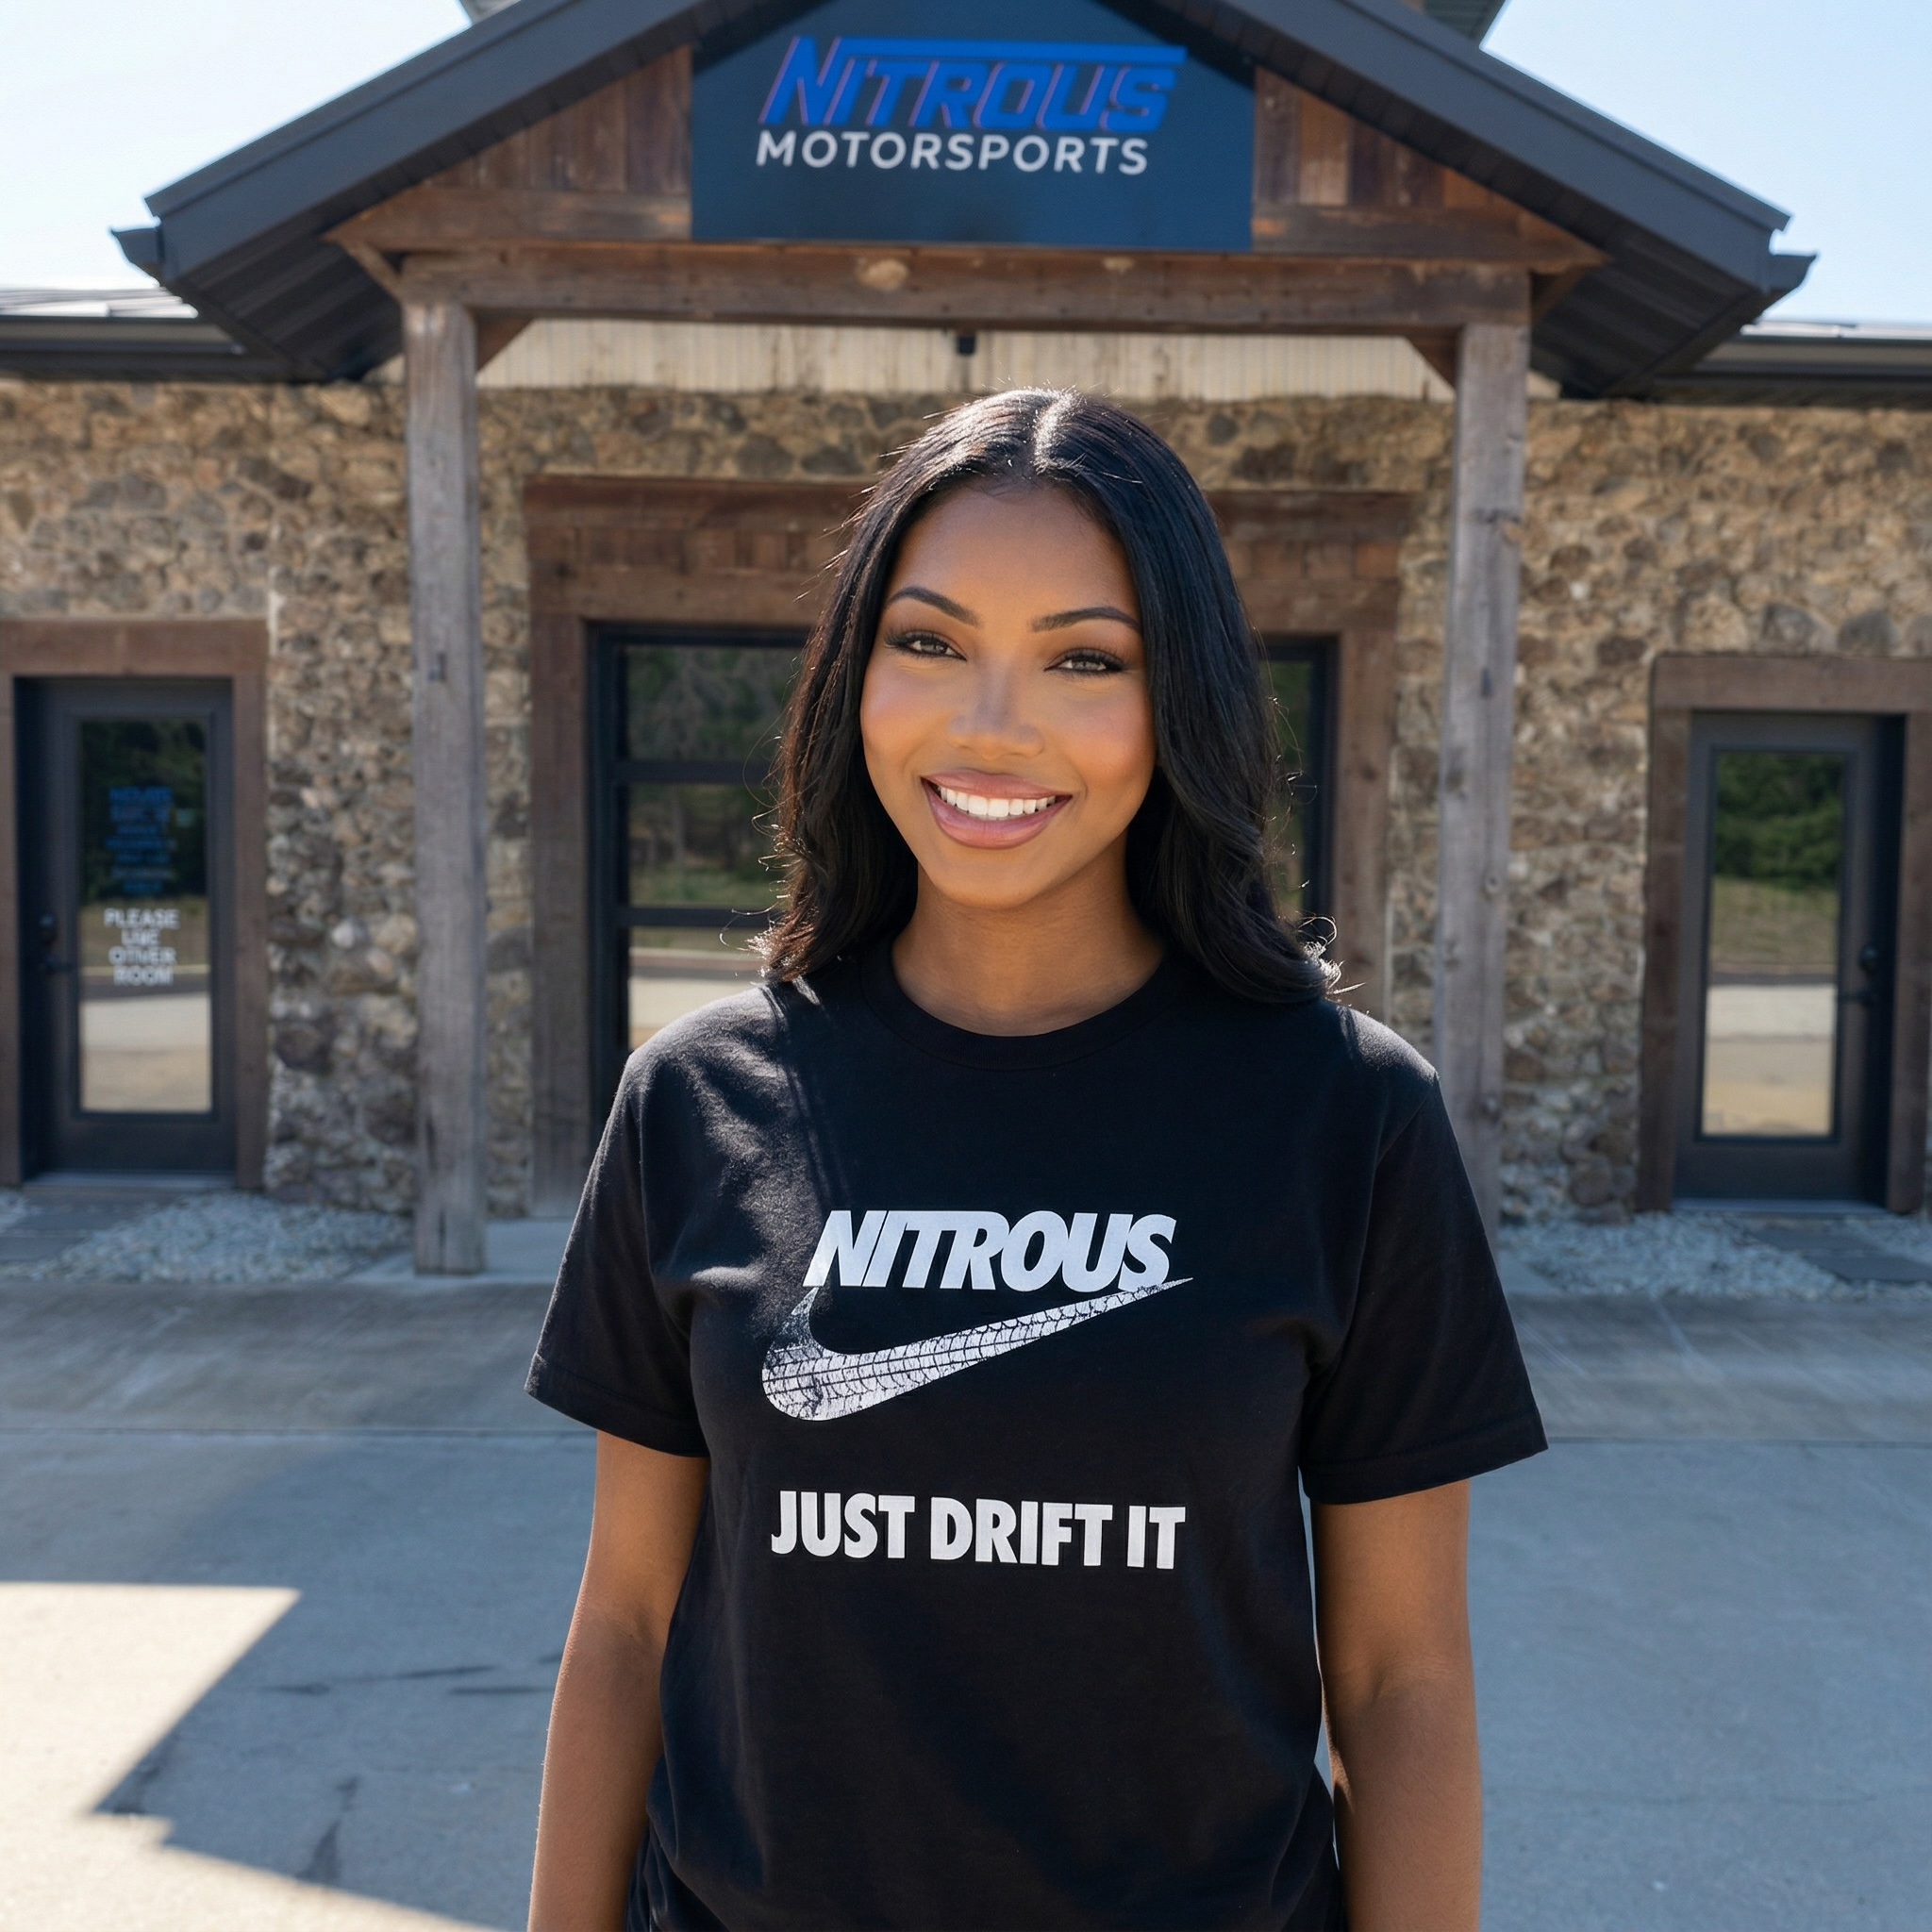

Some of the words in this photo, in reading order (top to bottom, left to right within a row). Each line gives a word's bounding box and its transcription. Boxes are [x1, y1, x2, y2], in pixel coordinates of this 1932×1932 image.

[758, 35, 1188, 131] NITROUS
[756, 130, 1148, 175] MOTORSPORTS
[104, 908, 180, 929] PLEASE
[108, 946, 177, 965] OTHER
[802, 1209, 1177, 1292] NITROUS
[771, 1491, 916, 1559] JUST
[930, 1497, 1113, 1567] DRIFT
[1127, 1506, 1186, 1570] IT
